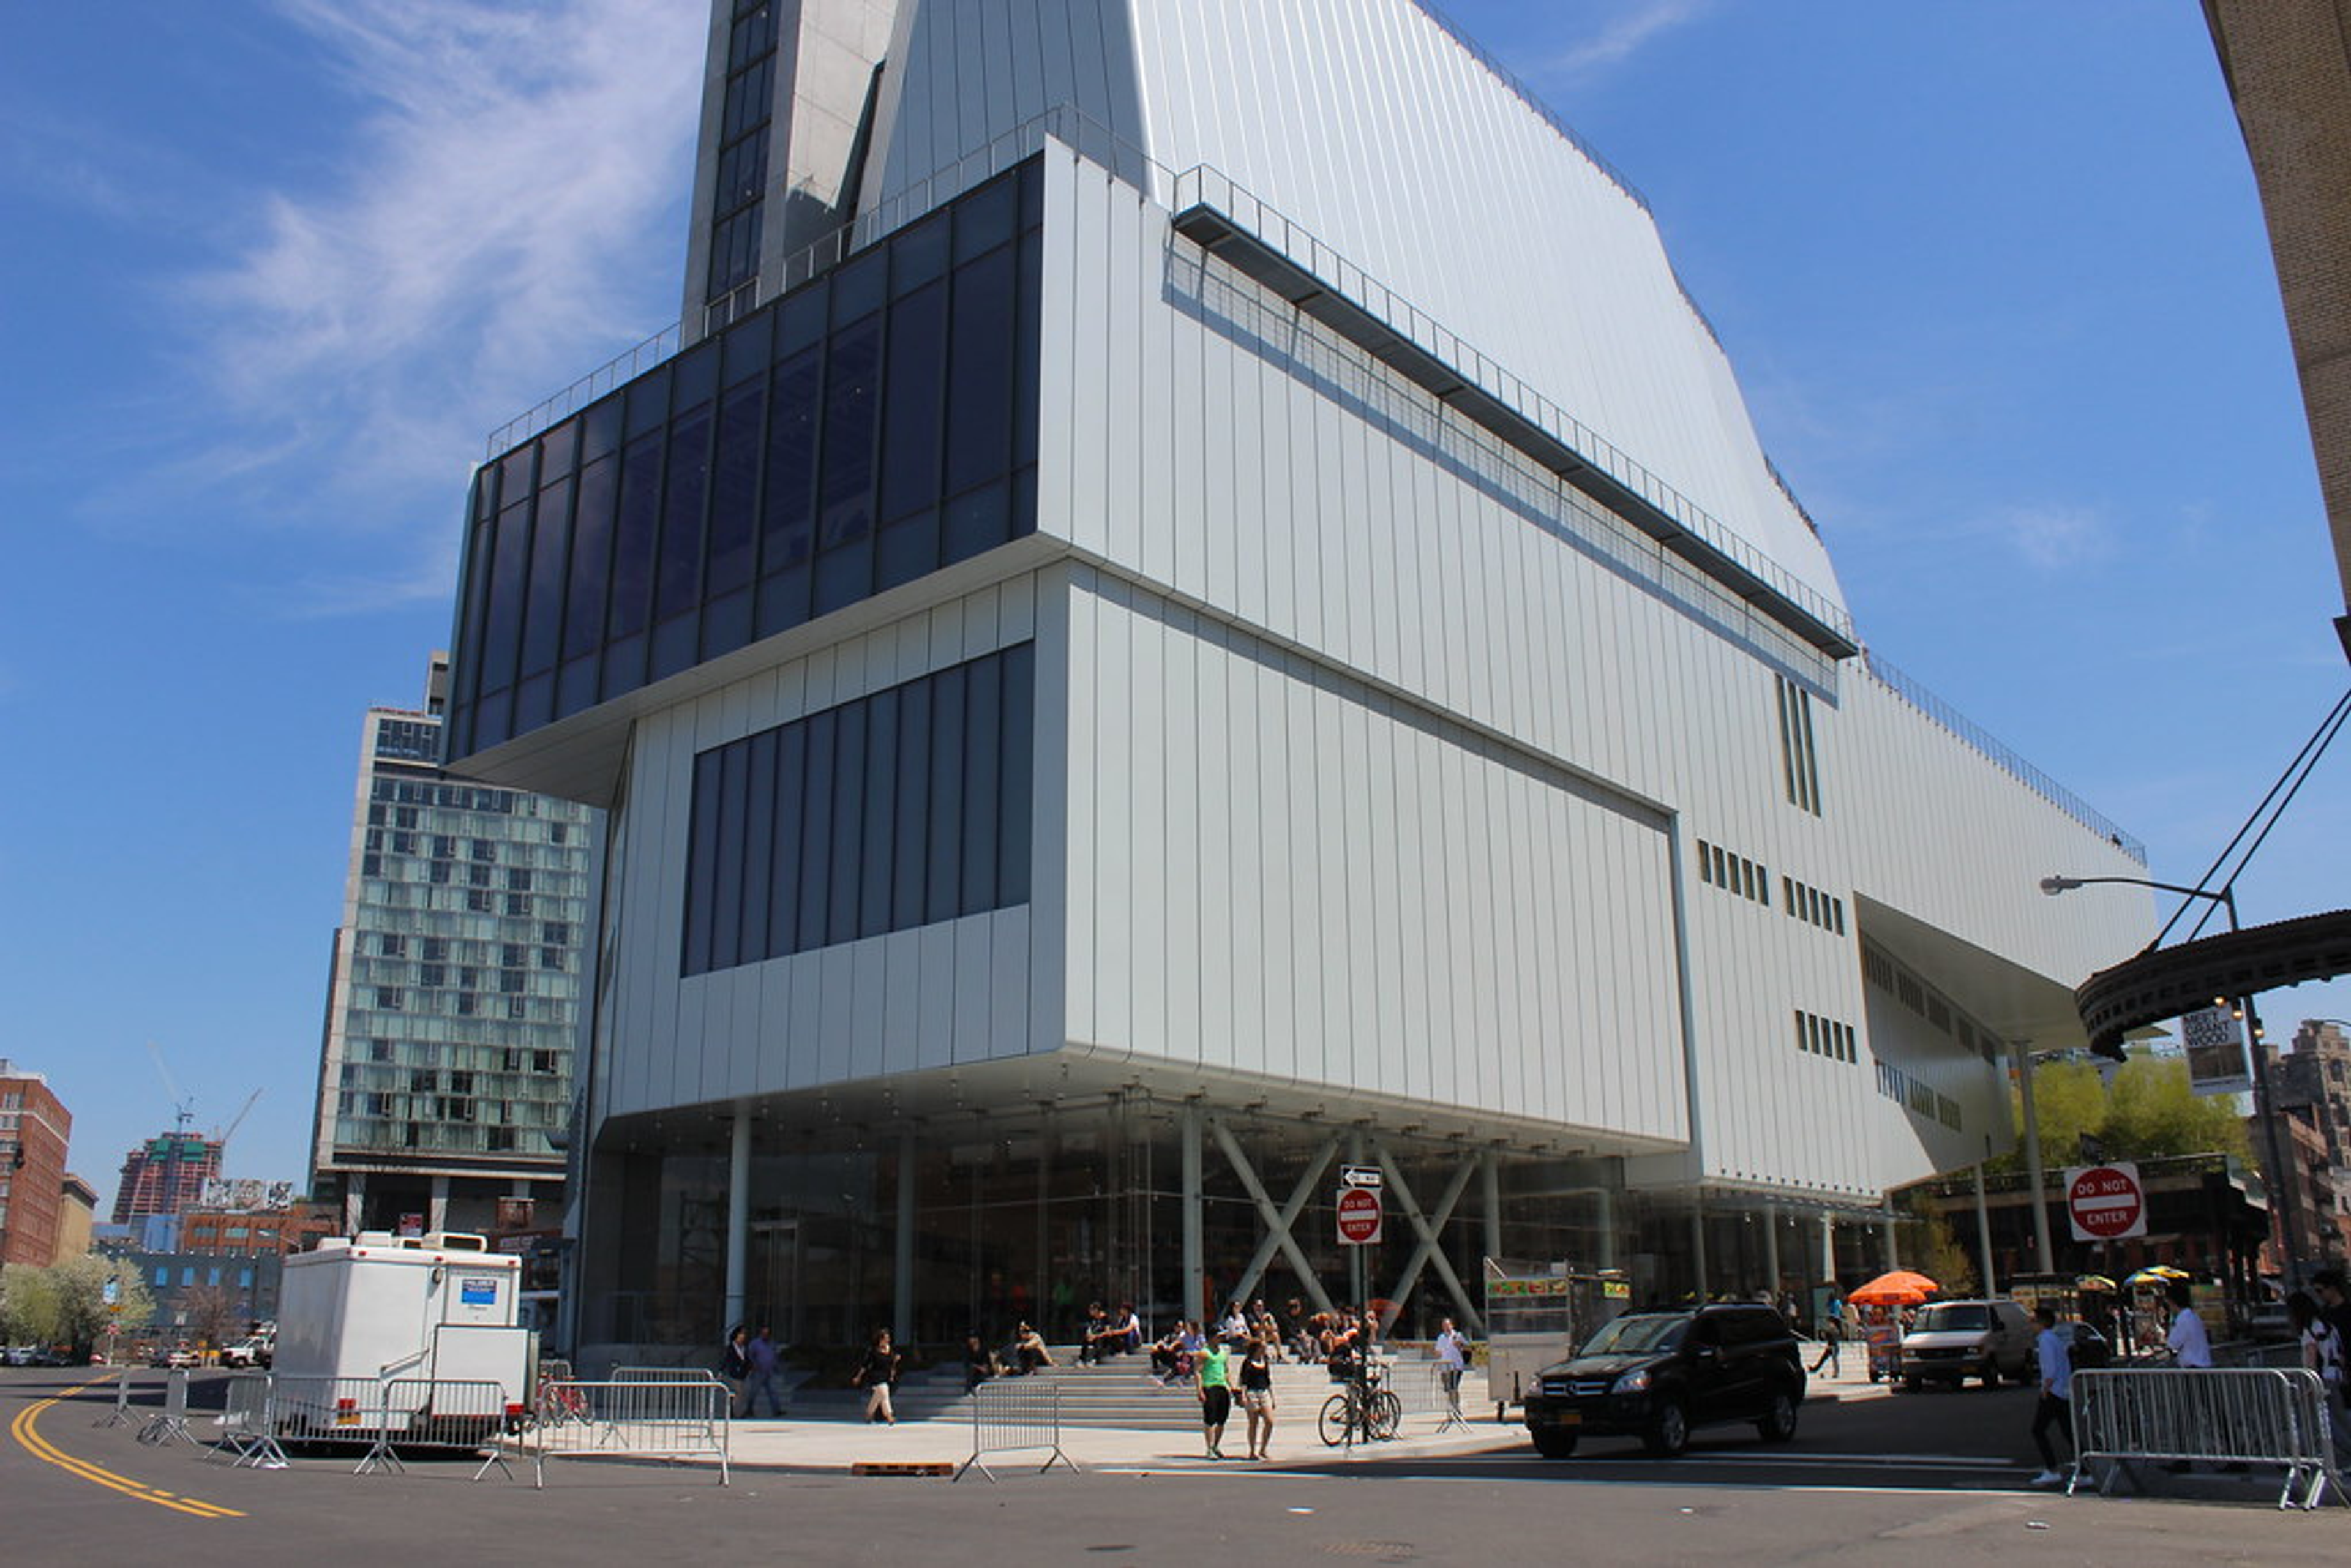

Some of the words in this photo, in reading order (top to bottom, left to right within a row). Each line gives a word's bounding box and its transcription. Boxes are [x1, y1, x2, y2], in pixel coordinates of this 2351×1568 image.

[2184, 1019, 2230, 1035] GRANT
[2186, 1032, 2229, 1046] WOOD
[2077, 1182, 2094, 1195] DO
[2101, 1179, 2127, 1192] NOT
[1343, 1200, 1355, 1209] DO
[2087, 1211, 2128, 1225] ENTER
